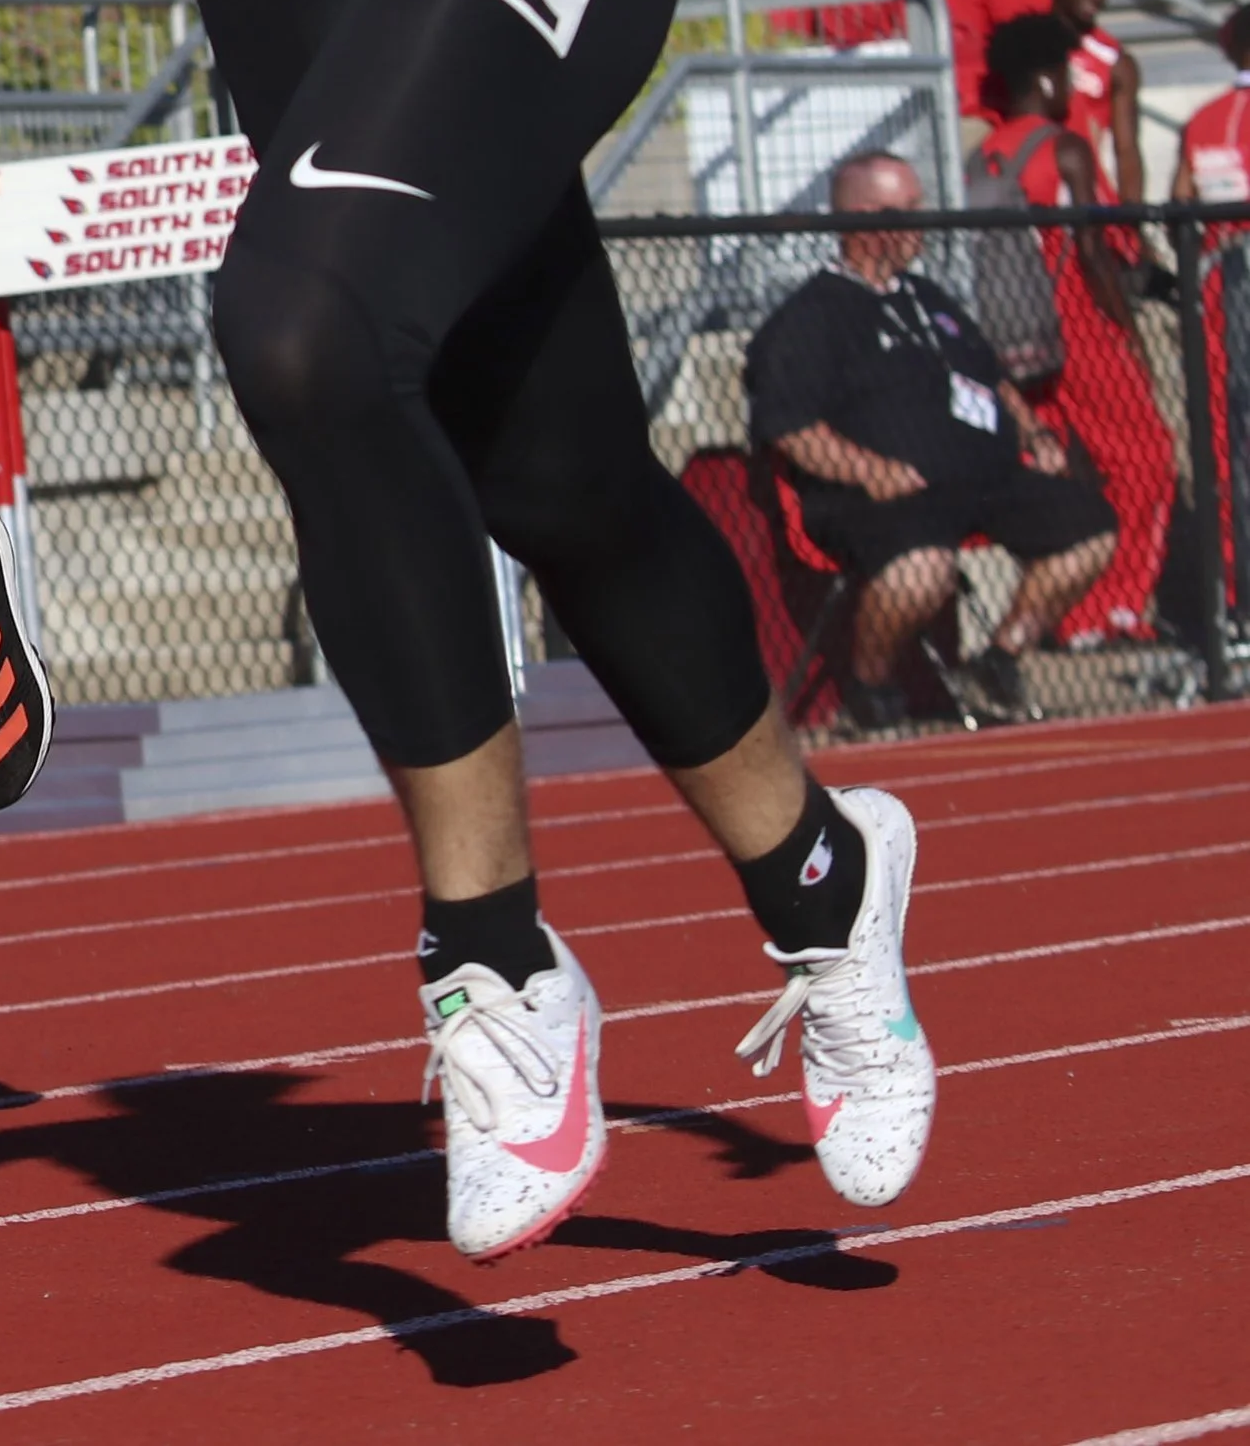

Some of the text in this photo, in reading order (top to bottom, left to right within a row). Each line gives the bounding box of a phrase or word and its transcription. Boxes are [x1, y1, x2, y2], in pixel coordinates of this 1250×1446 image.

[107, 151, 213, 180] SOUTH
[99, 181, 206, 212] SOUTH
[64, 235, 225, 276] SOUTH SH
